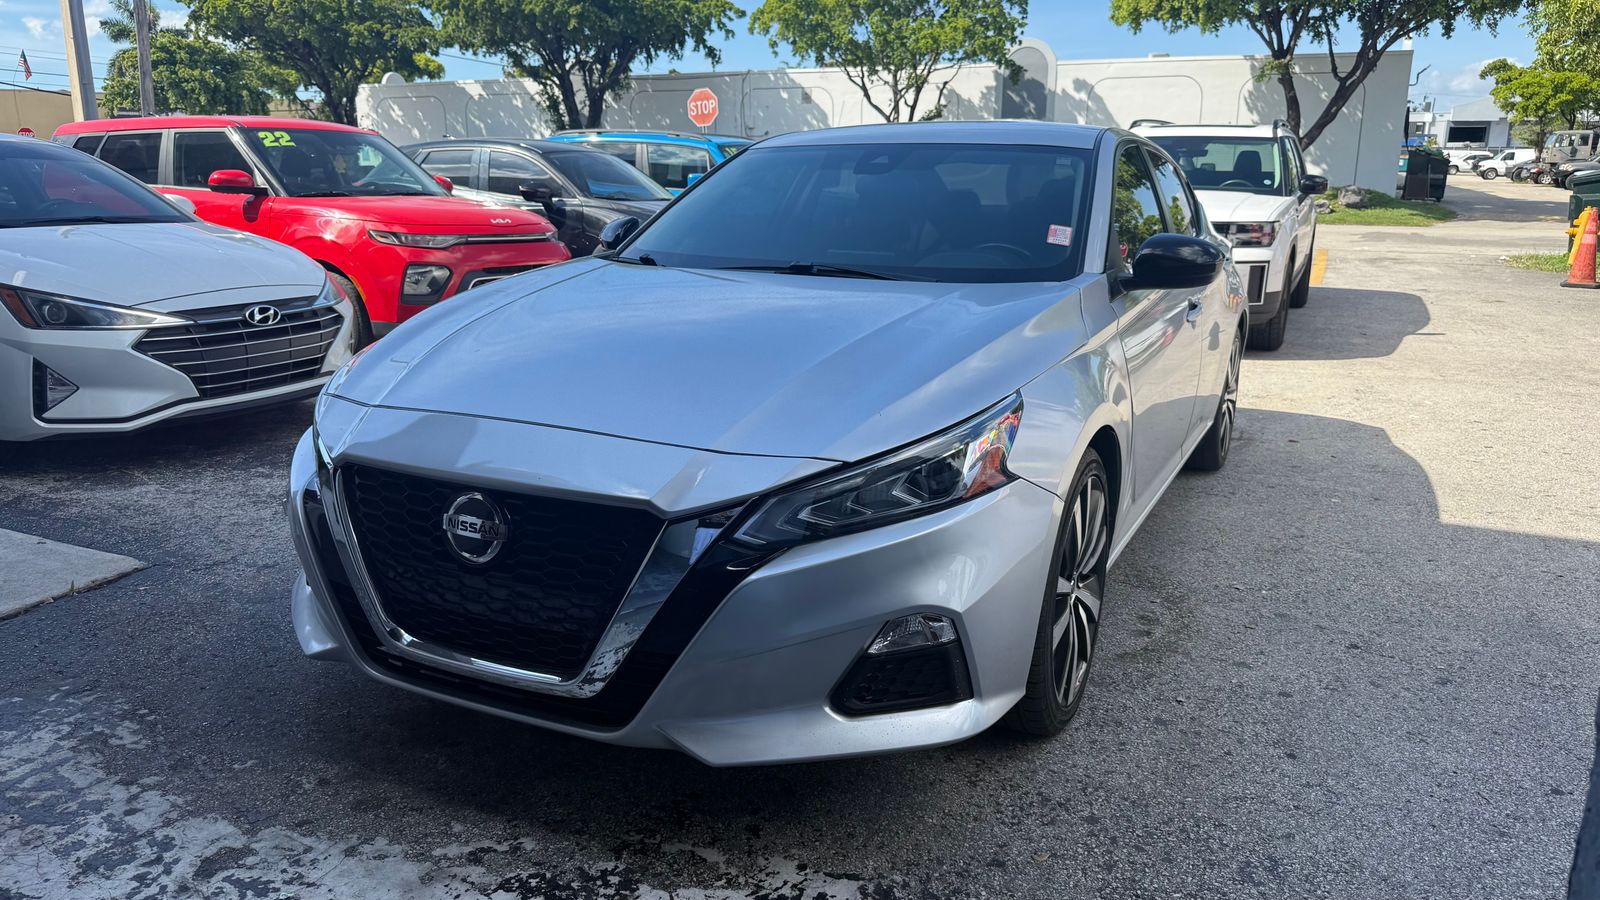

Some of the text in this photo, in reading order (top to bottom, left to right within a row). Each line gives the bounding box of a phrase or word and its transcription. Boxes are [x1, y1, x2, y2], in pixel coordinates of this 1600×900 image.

[690, 99, 716, 116] STOP
[258, 131, 296, 147] 22
[447, 518, 499, 537] NISSAN
